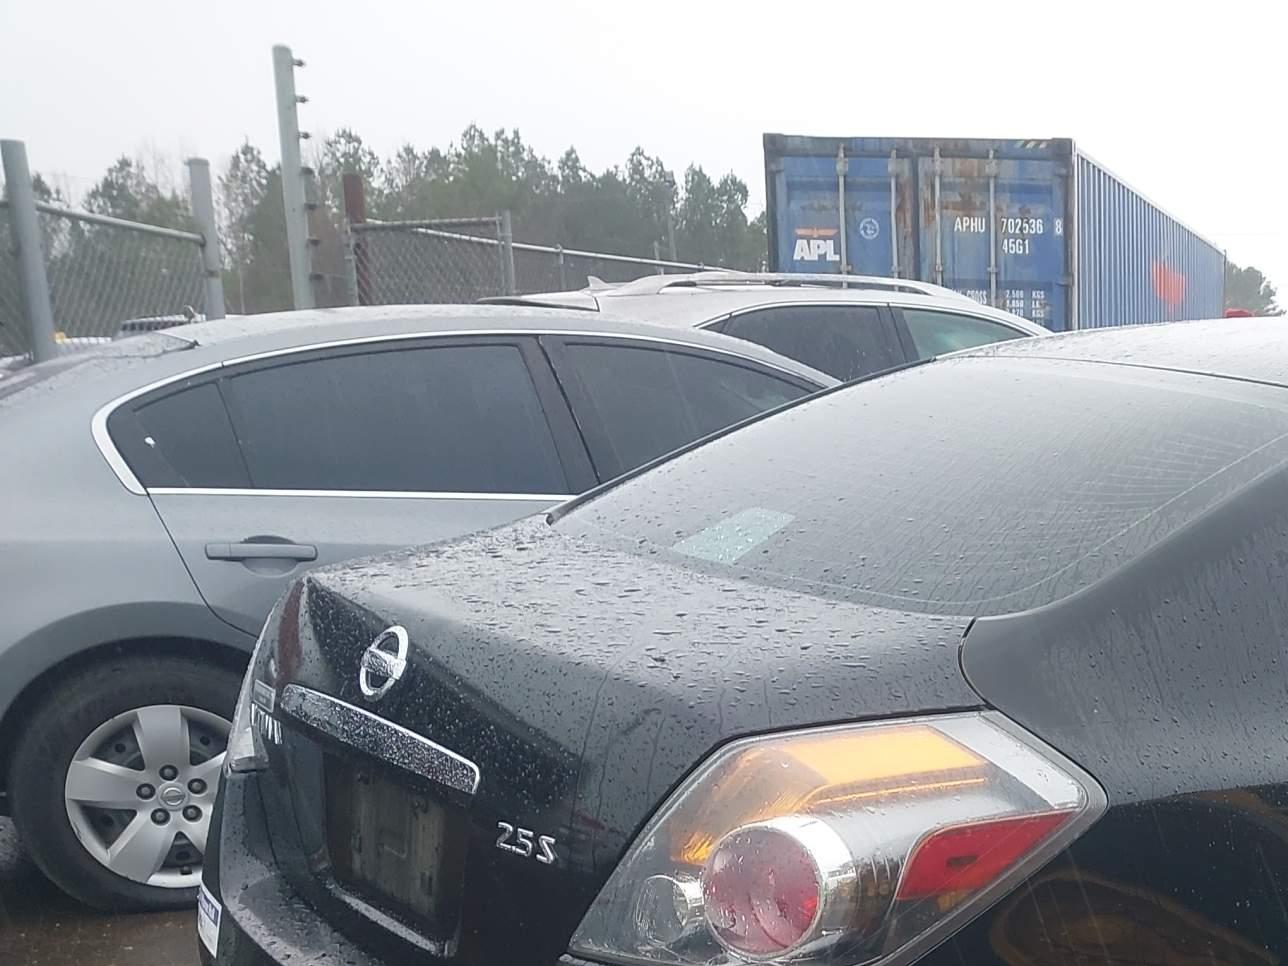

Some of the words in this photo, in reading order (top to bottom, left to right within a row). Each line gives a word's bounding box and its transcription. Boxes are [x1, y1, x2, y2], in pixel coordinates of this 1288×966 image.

[954, 217, 986, 233] APHU
[1000, 218, 1043, 234] 702536
[1055, 218, 1063, 235] 8
[793, 239, 840, 261] APL
[1002, 239, 1029, 254] 45G1
